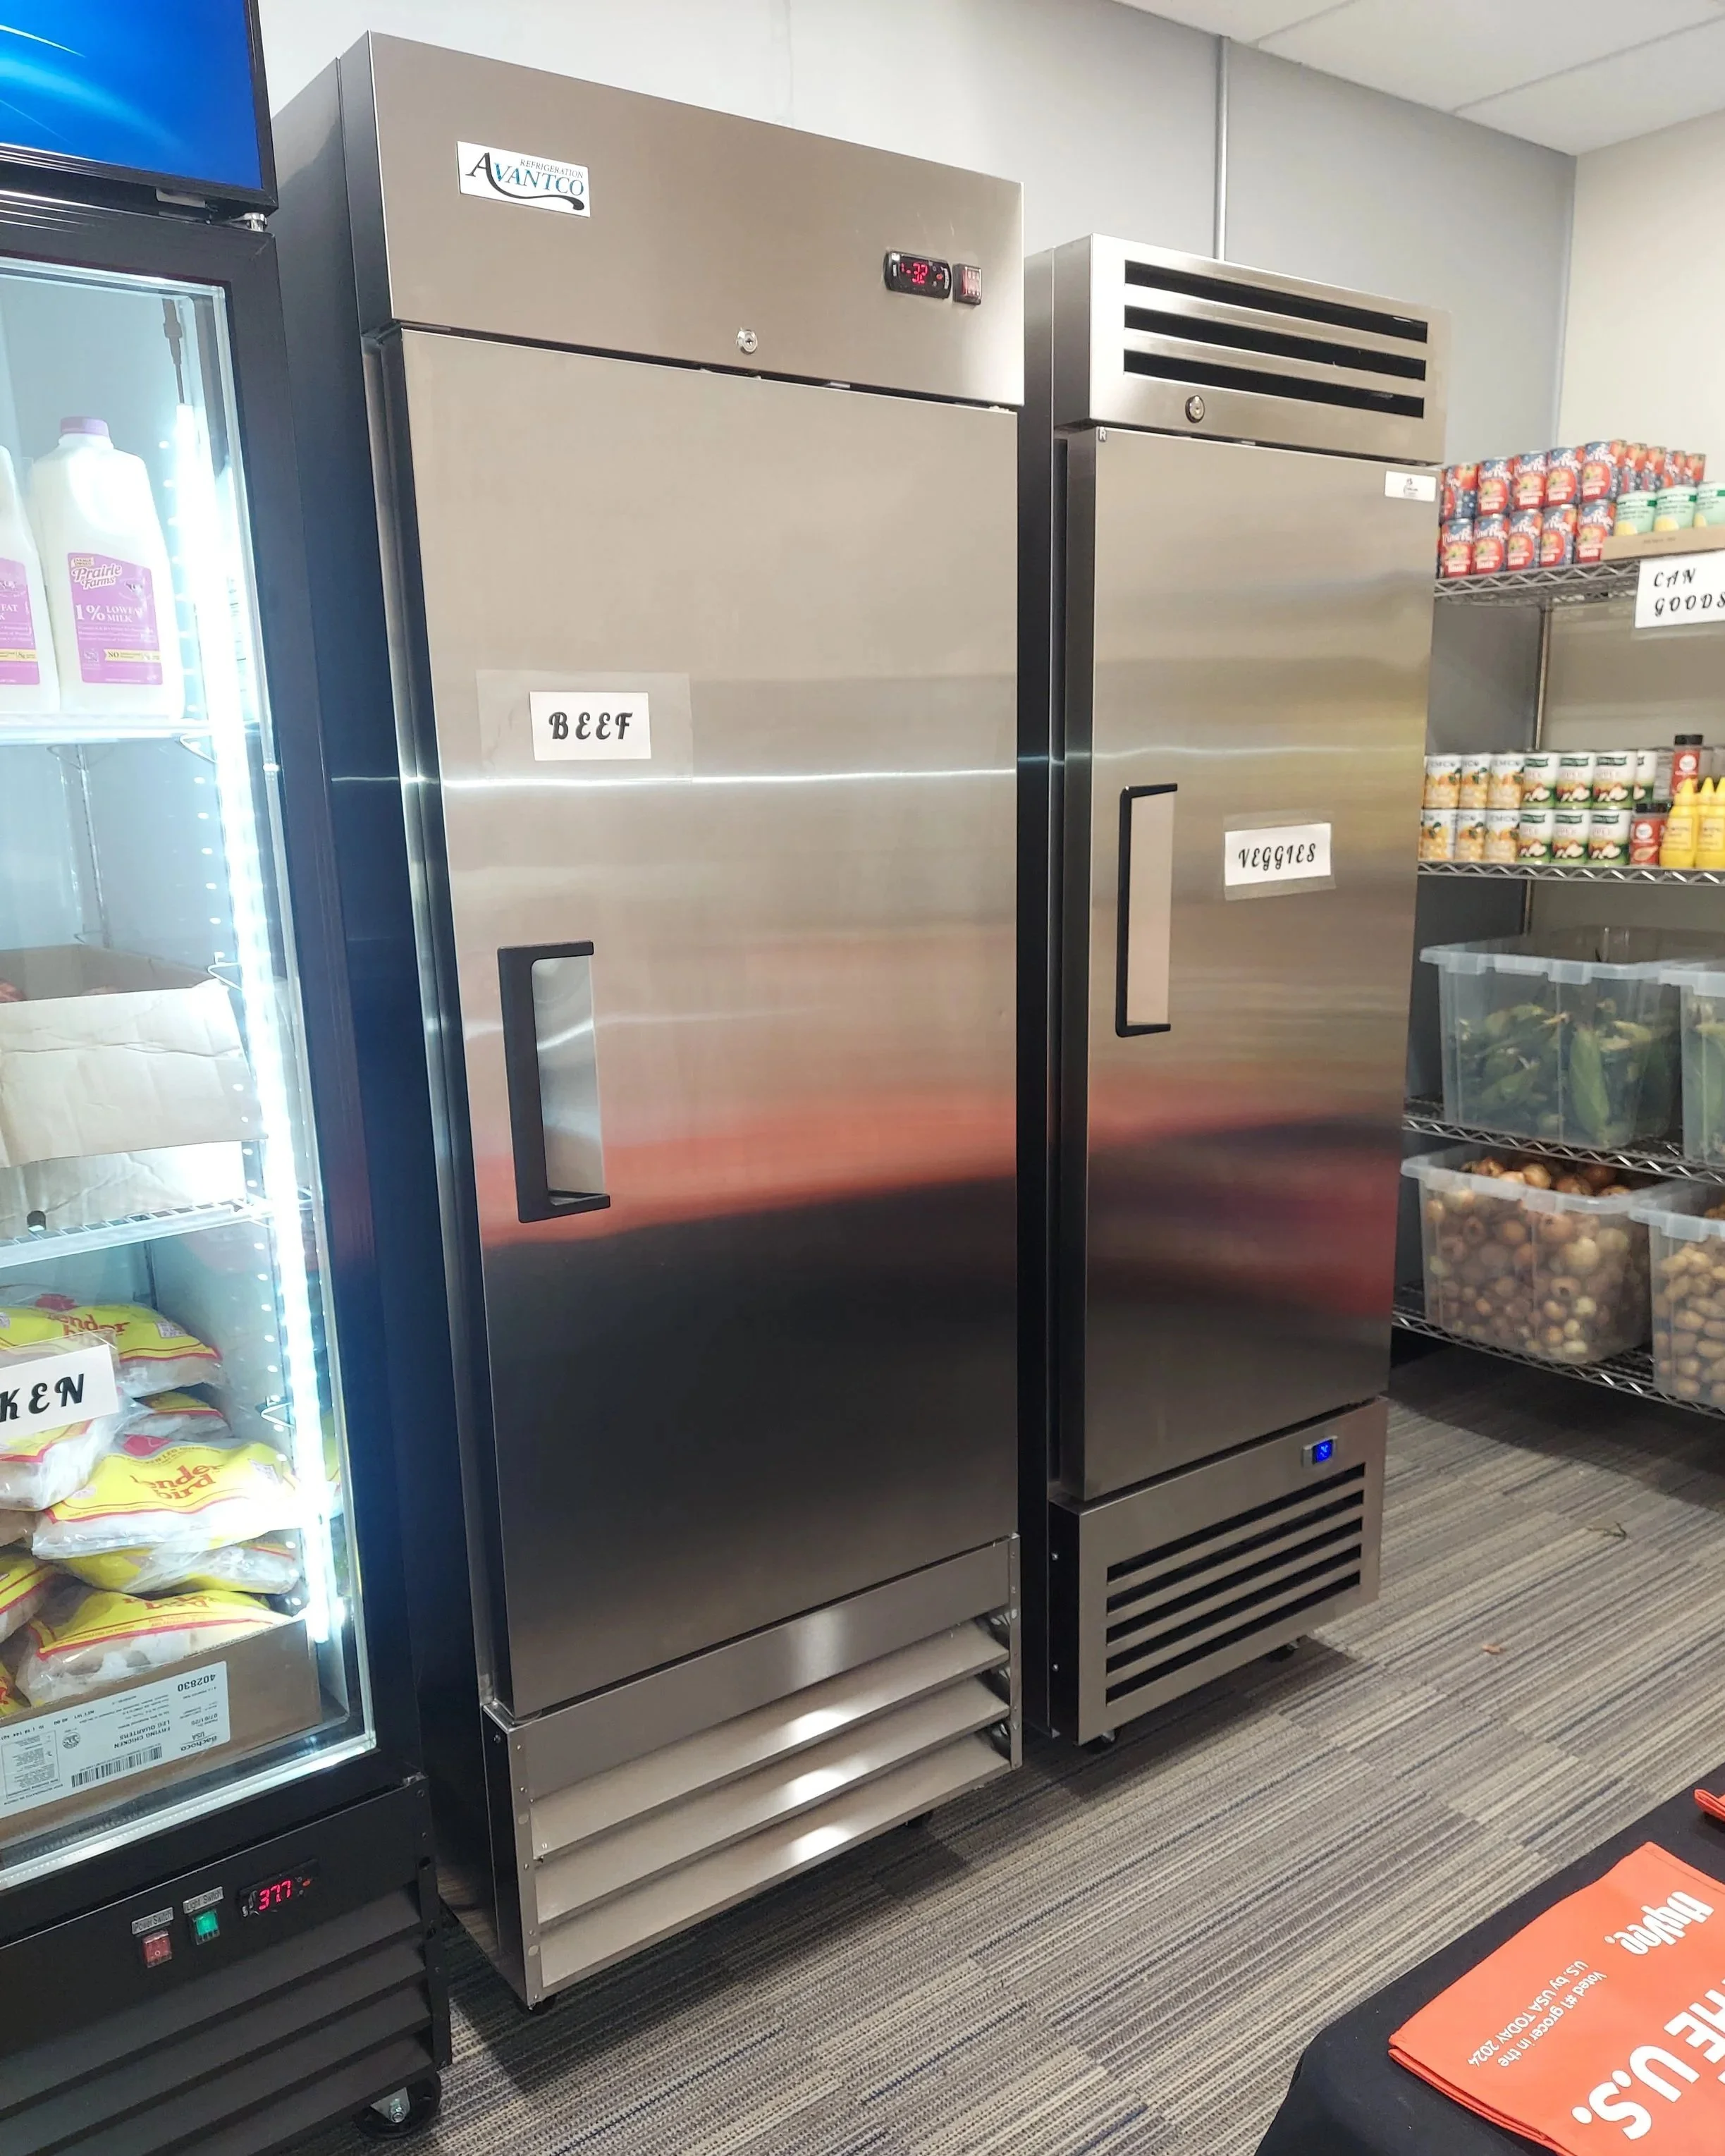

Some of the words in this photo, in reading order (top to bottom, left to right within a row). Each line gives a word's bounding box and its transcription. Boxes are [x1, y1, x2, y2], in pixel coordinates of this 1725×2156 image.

[520, 159, 583, 178] REFRIGERATION
[465, 152, 584, 210] AVANTCO
[72, 564, 121, 582] Prairie
[1654, 568, 1695, 587] CAN
[82, 577, 115, 589] Farms
[106, 606, 144, 618] LOWFA
[1655, 592, 1725, 617] GOODS
[548, 711, 633, 740] BEEF
[1239, 843, 1316, 871] VEGGIES
[178, 1674, 216, 1692] 402830
[192, 1732, 205, 1741] USA
[153, 1911, 172, 1925] Switch
[1563, 1960, 1589, 1976] U.S.
[1549, 1976, 1571, 1990] by
[1572, 1972, 1607, 1997] Voted
[1528, 1990, 1557, 2011] USA
[1560, 1994, 1578, 2009] #1
[1494, 2011, 1537, 2044] TODAY
[1529, 2005, 1564, 2040] grocer
[1663, 1978, 1725, 2064] HE
[1467, 2040, 1500, 2067] 2024
[1516, 2038, 1535, 2050] in
[1497, 2048, 1522, 2067] the
[1571, 2045, 1700, 2140] U.S.
